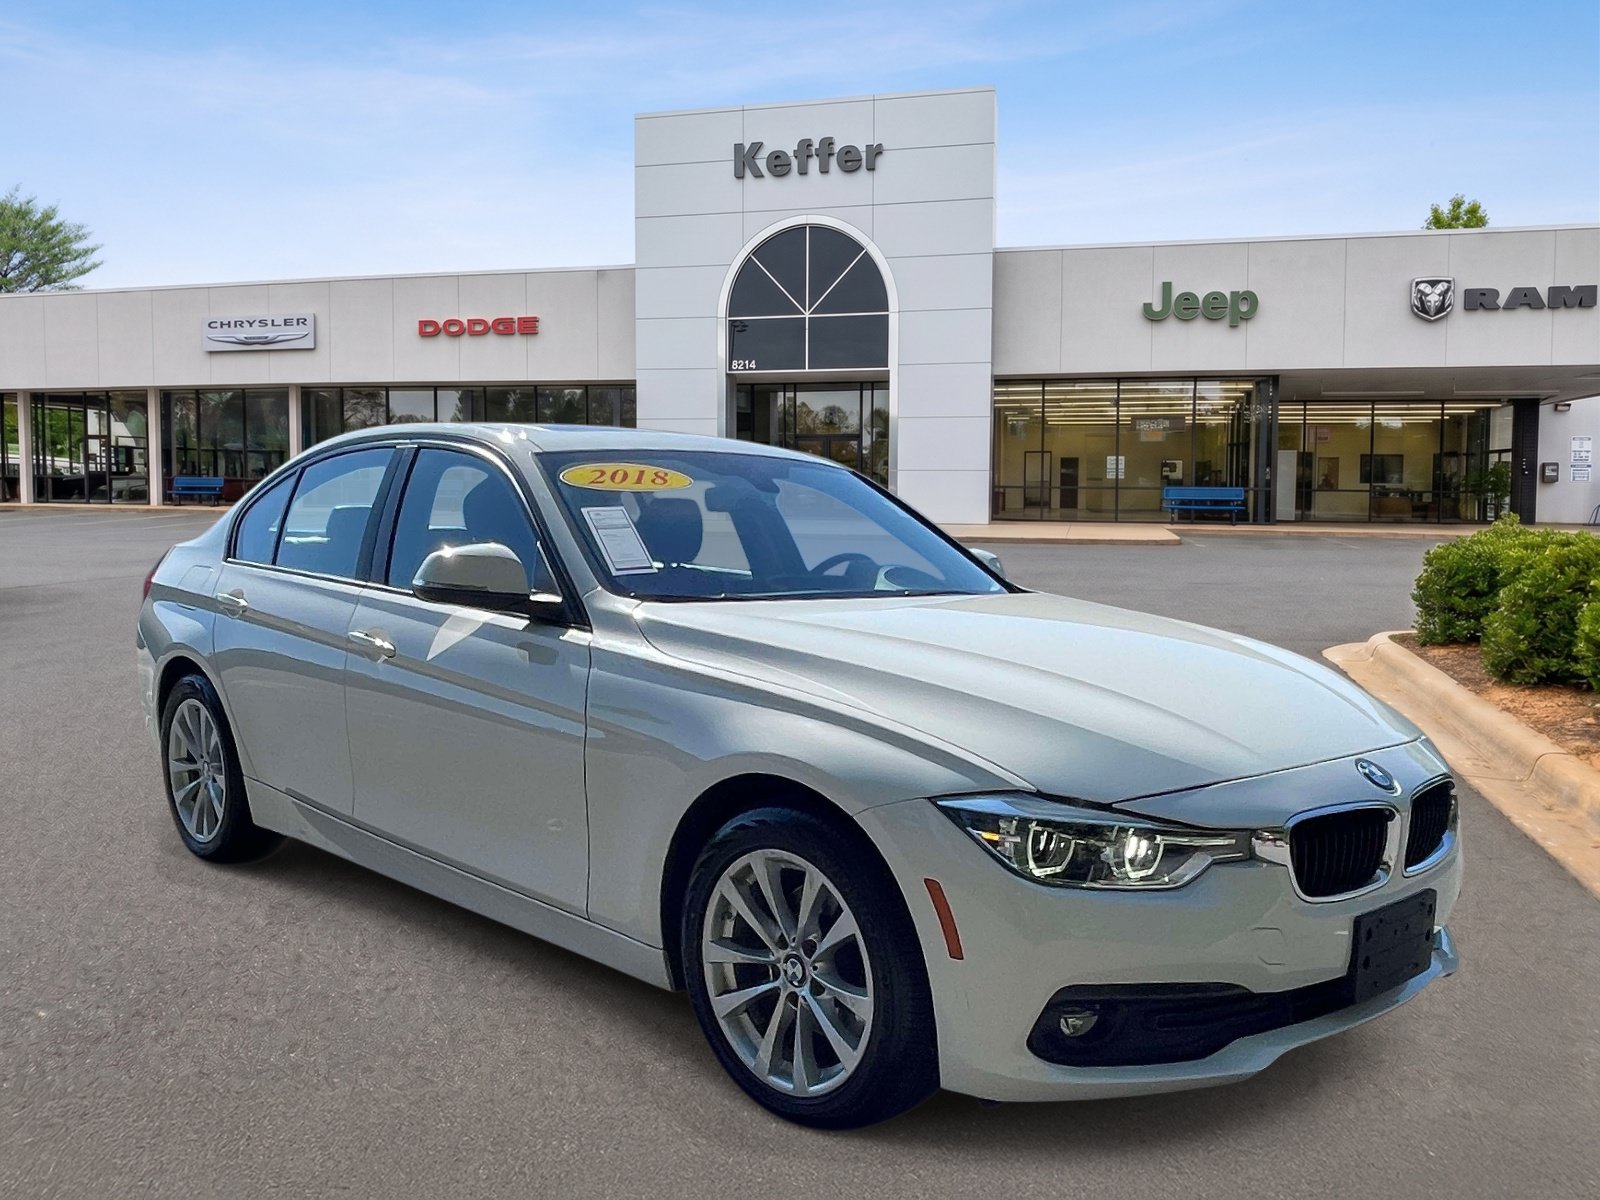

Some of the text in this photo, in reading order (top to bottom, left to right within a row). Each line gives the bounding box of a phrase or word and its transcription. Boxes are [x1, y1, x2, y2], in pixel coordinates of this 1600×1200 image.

[733, 136, 884, 179] Keffer
[1143, 281, 1259, 328] Jeep
[1464, 285, 1598, 311] RAM
[207, 317, 309, 330] CHRYSLER
[418, 316, 539, 337] DODGE
[731, 360, 757, 370] 8214
[588, 469, 669, 486] 2018
